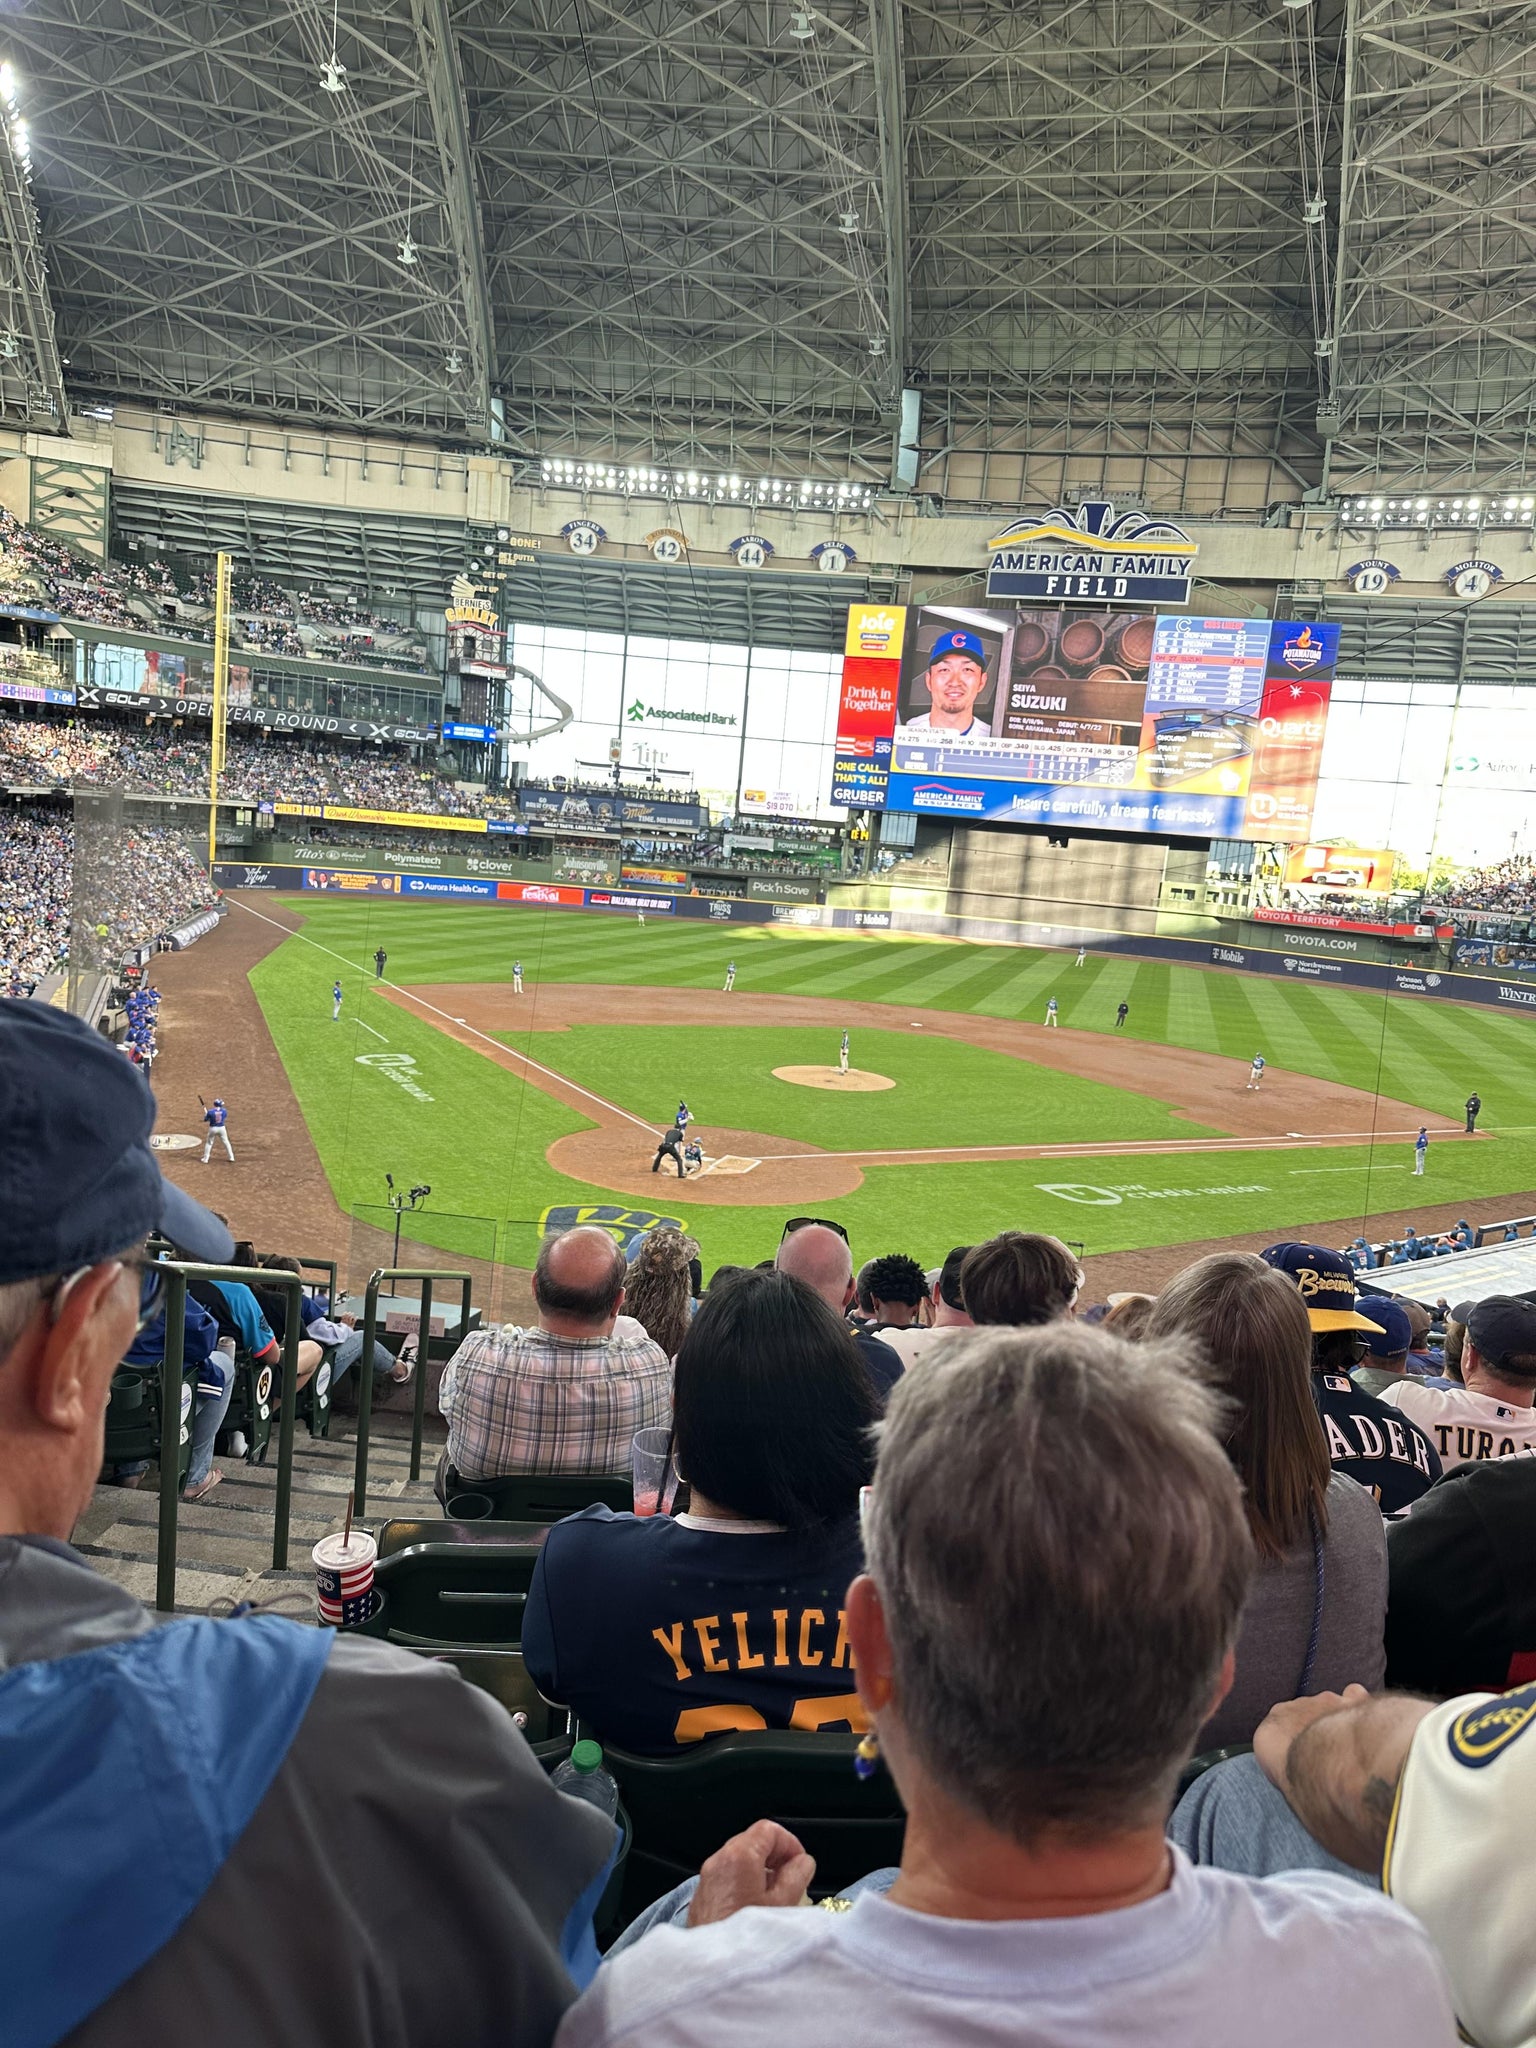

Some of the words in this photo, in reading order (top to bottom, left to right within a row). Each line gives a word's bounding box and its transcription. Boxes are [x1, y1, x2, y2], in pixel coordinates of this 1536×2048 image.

[569, 520, 600, 532] FINGERS
[510, 537, 541, 549] GONE!
[573, 533, 593, 548] 34
[741, 536, 764, 546] AARON
[823, 542, 845, 553] SELIG
[657, 541, 677, 557] 42
[741, 549, 760, 563] 44
[990, 553, 1103, 574] AMERICAN
[1111, 556, 1193, 576] FAMILY
[1360, 560, 1389, 570] YOUNT
[1455, 561, 1496, 573] MOLITOR
[1046, 576, 1127, 597] FIELD
[1361, 574, 1385, 590] 19
[1465, 575, 1478, 592] 4
[455, 598, 491, 610] BERNIE'S
[445, 606, 499, 627] CHALET
[858, 611, 895, 631] Joie
[1283, 648, 1322, 661] POTAWATOMI
[847, 685, 878, 698] Drink
[881, 688, 891, 699] in
[1013, 683, 1036, 693] SEIYA
[843, 697, 894, 712] Together
[1011, 694, 1067, 711] SUZUKI
[105, 692, 151, 706] GOLF
[226, 706, 264, 723] YEAR
[275, 714, 338, 731] ROUND
[393, 730, 437, 741] GOLF
[646, 706, 710, 723] Associated
[711, 712, 737, 726] Bank
[1058, 721, 1078, 729] DEBUT:
[1260, 717, 1322, 738] Quartz
[875, 745, 891, 753] 250
[836, 761, 856, 772] ONE
[834, 772, 866, 785] THAT'S
[867, 776, 887, 786] ALL!
[834, 788, 885, 802] GRUBER
[914, 791, 953, 801] AMERICAN
[955, 794, 983, 803] FAMILY
[917, 800, 977, 809] INSURANCE
[1012, 794, 1050, 812] Insure
[1052, 797, 1107, 818] carefully,
[1110, 801, 1149, 820] dream
[1152, 804, 1216, 827] fearlessly.
[622, 805, 655, 819] Miller
[777, 842, 798, 850] POWER
[799, 843, 818, 851] ALLEY
[294, 848, 325, 860] Tito's
[384, 853, 441, 865] Polymatech
[479, 858, 512, 871] clover
[563, 857, 608, 871] Johnsonville
[424, 882, 448, 891] Aurora
[449, 884, 471, 893] Health
[472, 886, 488, 894] Care
[522, 886, 559, 902] festival
[752, 881, 774, 892] Pick
[783, 884, 809, 896] Save
[863, 914, 889, 926] Mobile
[1256, 910, 1290, 922] TOYOTA
[1291, 914, 1341, 927] TERRITORY
[1284, 933, 1357, 951] TOYOTA.COM
[1220, 949, 1244, 964] Mobile
[1297, 966, 1320, 975] Mutual
[1298, 960, 1342, 971] Northwestern
[1396, 975, 1422, 984] Johnson
[1400, 981, 1426, 991] Controls
[1323, 1413, 1431, 1482] ADER
